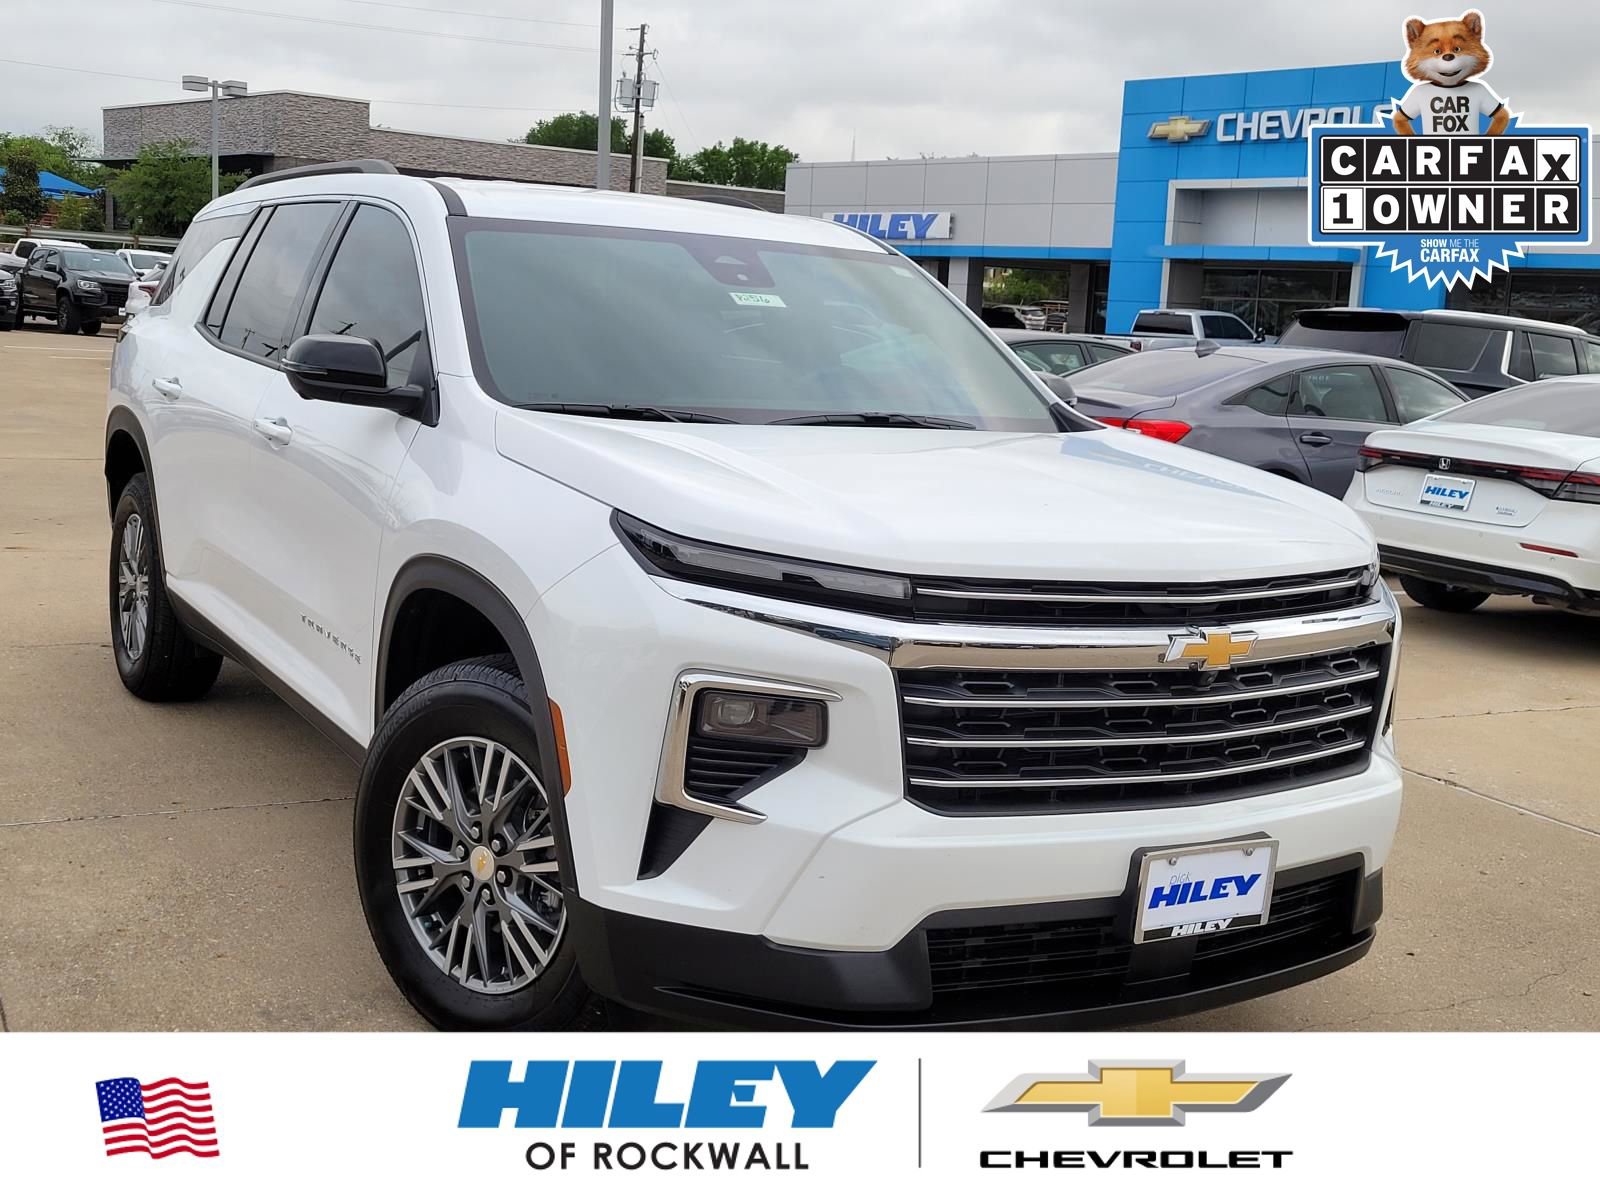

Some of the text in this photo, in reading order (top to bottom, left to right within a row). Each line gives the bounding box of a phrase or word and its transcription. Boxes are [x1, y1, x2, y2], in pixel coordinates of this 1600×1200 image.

[1424, 486, 1470, 500] HILEY
[1148, 873, 1262, 910] HILEY
[1170, 918, 1233, 937] HILEY
